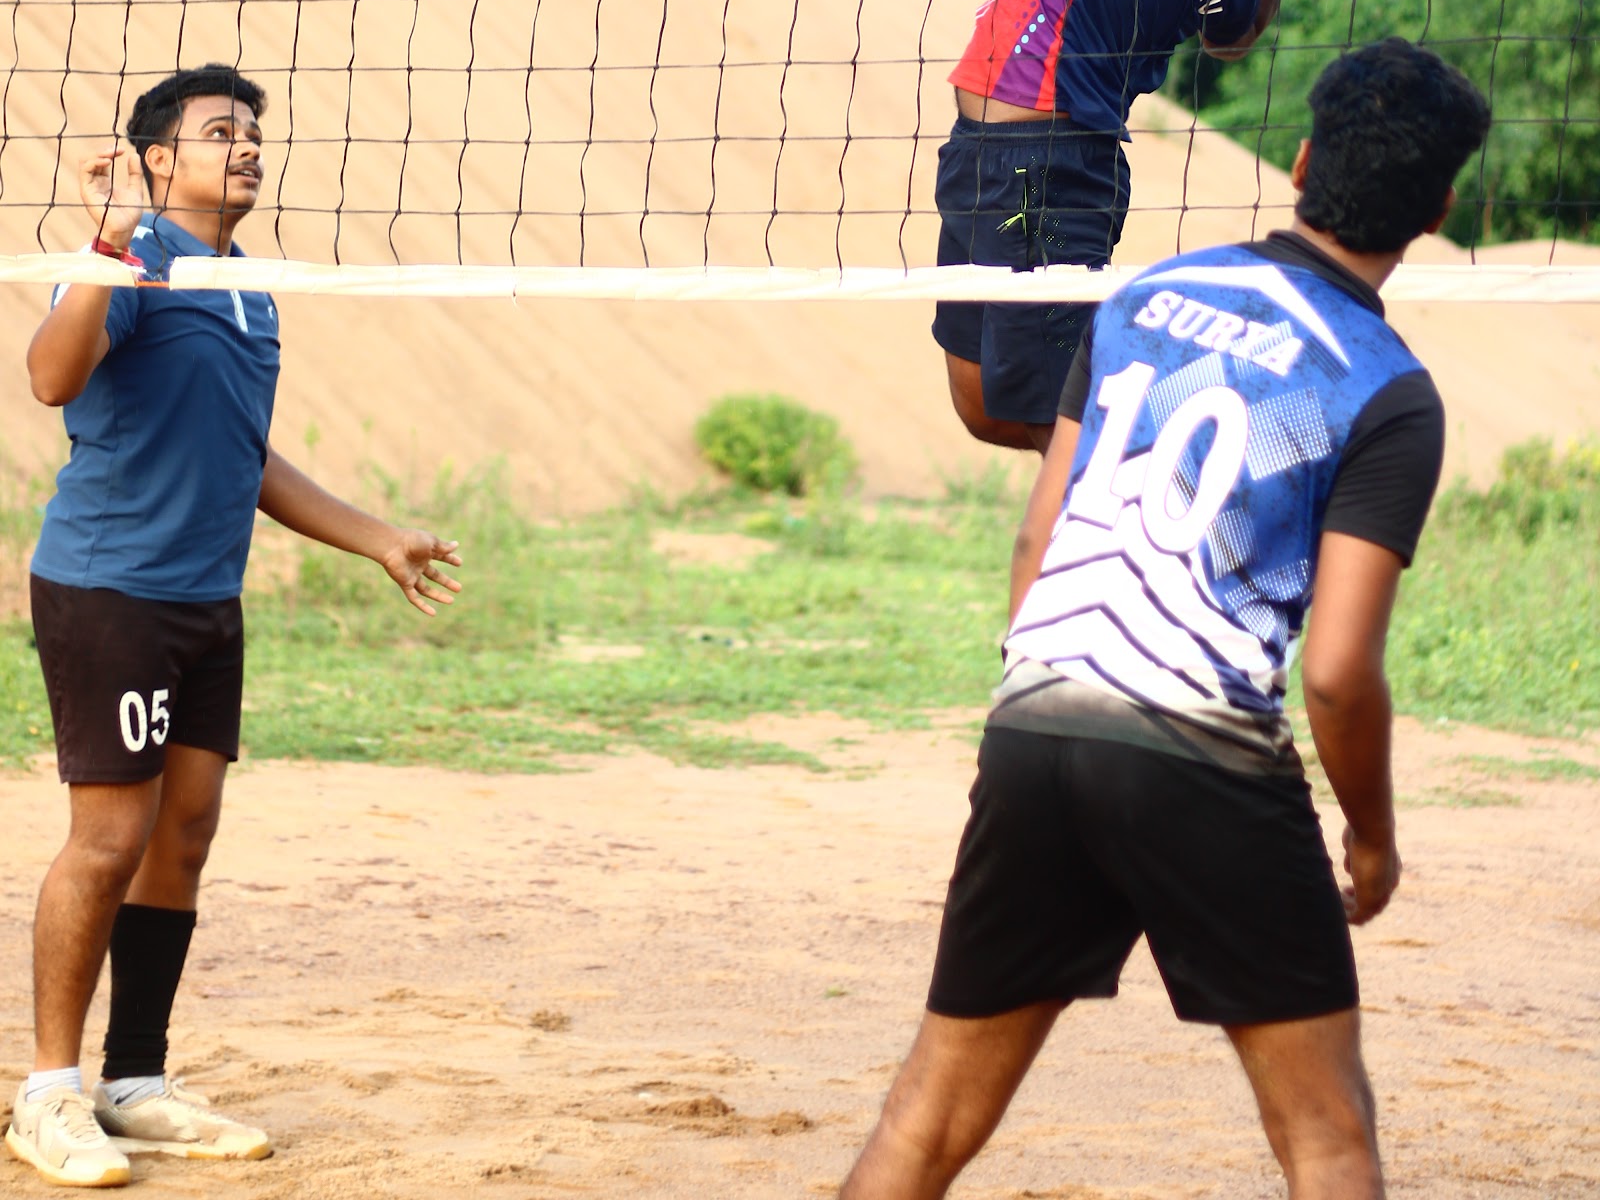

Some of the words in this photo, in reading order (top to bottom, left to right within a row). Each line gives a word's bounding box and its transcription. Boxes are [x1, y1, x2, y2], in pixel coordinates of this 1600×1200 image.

[1133, 290, 1303, 377] SURYA
[1066, 360, 1249, 553] 10
[119, 688, 170, 752] 05
